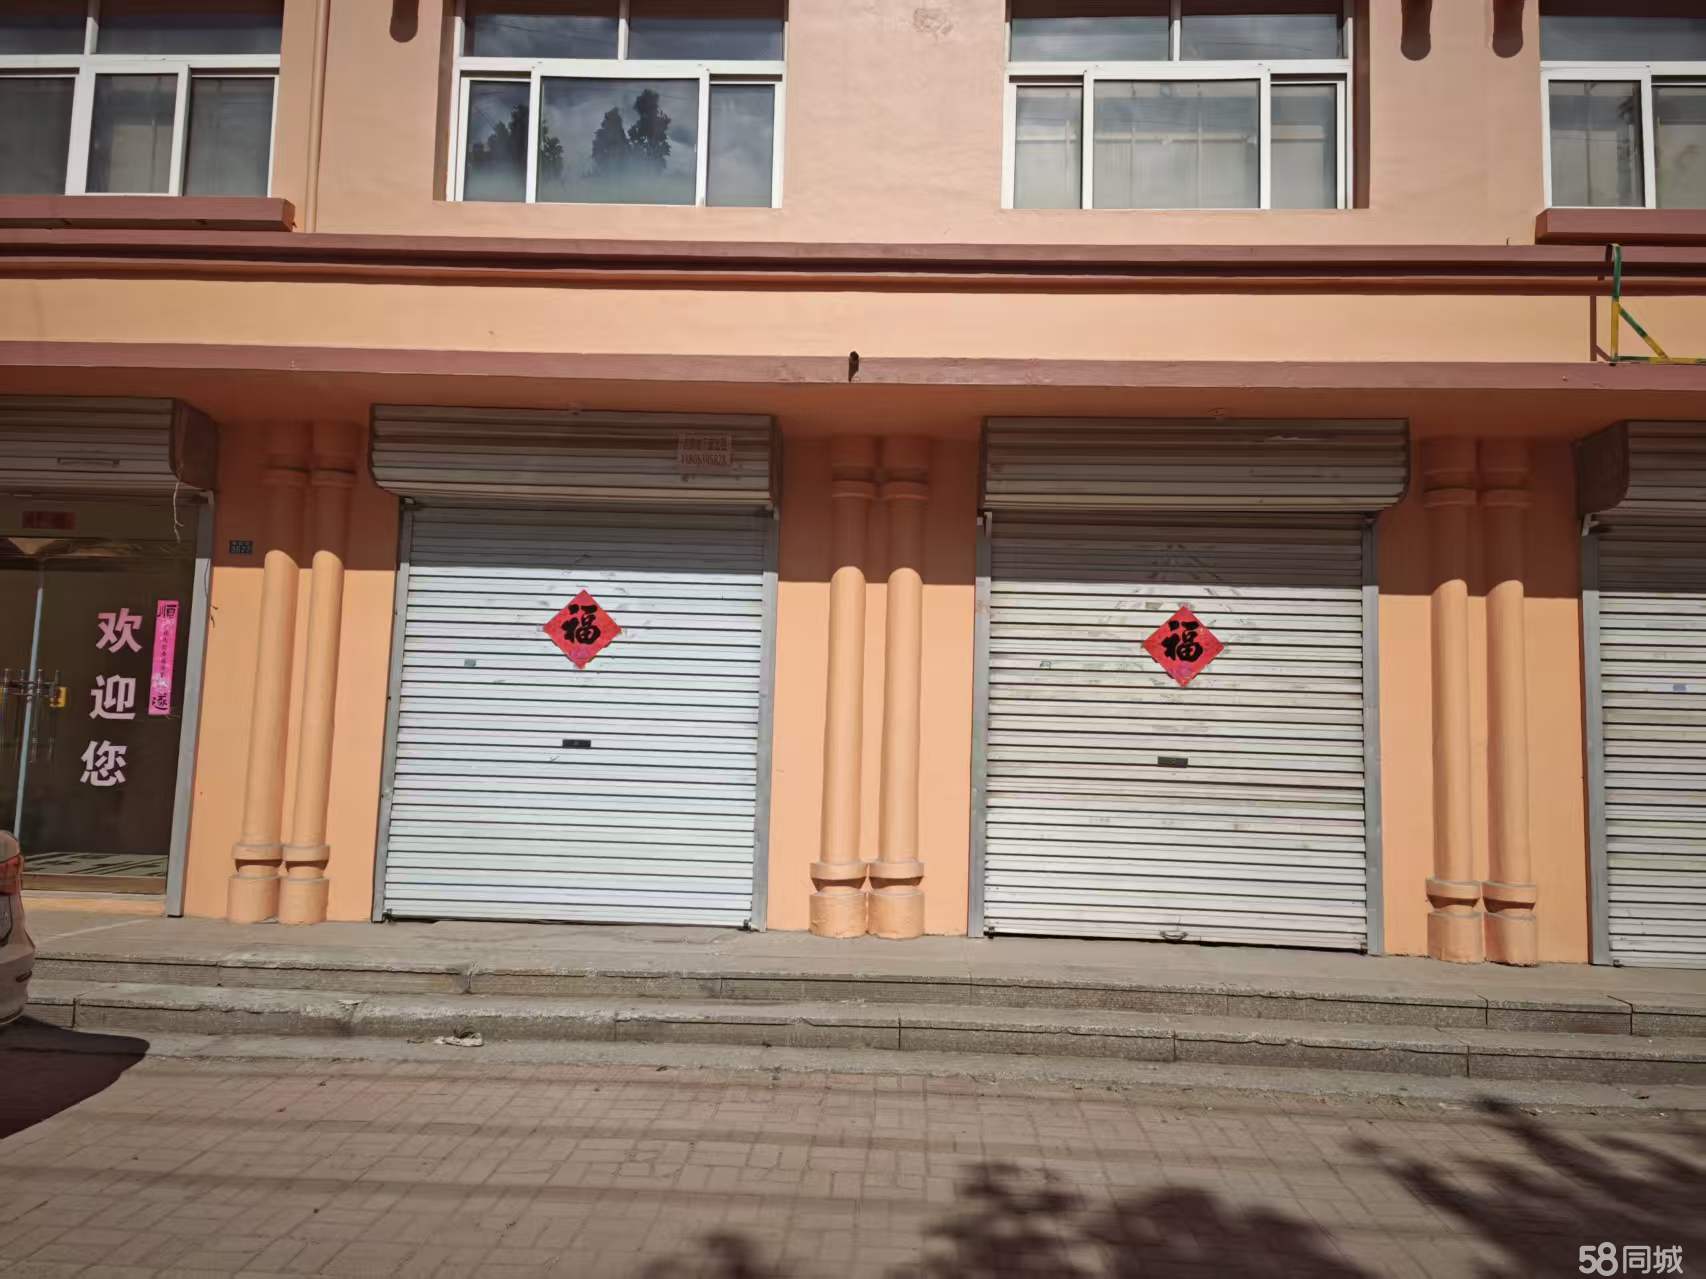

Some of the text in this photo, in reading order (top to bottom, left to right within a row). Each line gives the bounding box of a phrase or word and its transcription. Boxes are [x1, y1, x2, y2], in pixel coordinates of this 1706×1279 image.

[561, 603, 601, 645] 福
[1161, 620, 1204, 662] 福
[79, 607, 143, 787] 欢迎您
